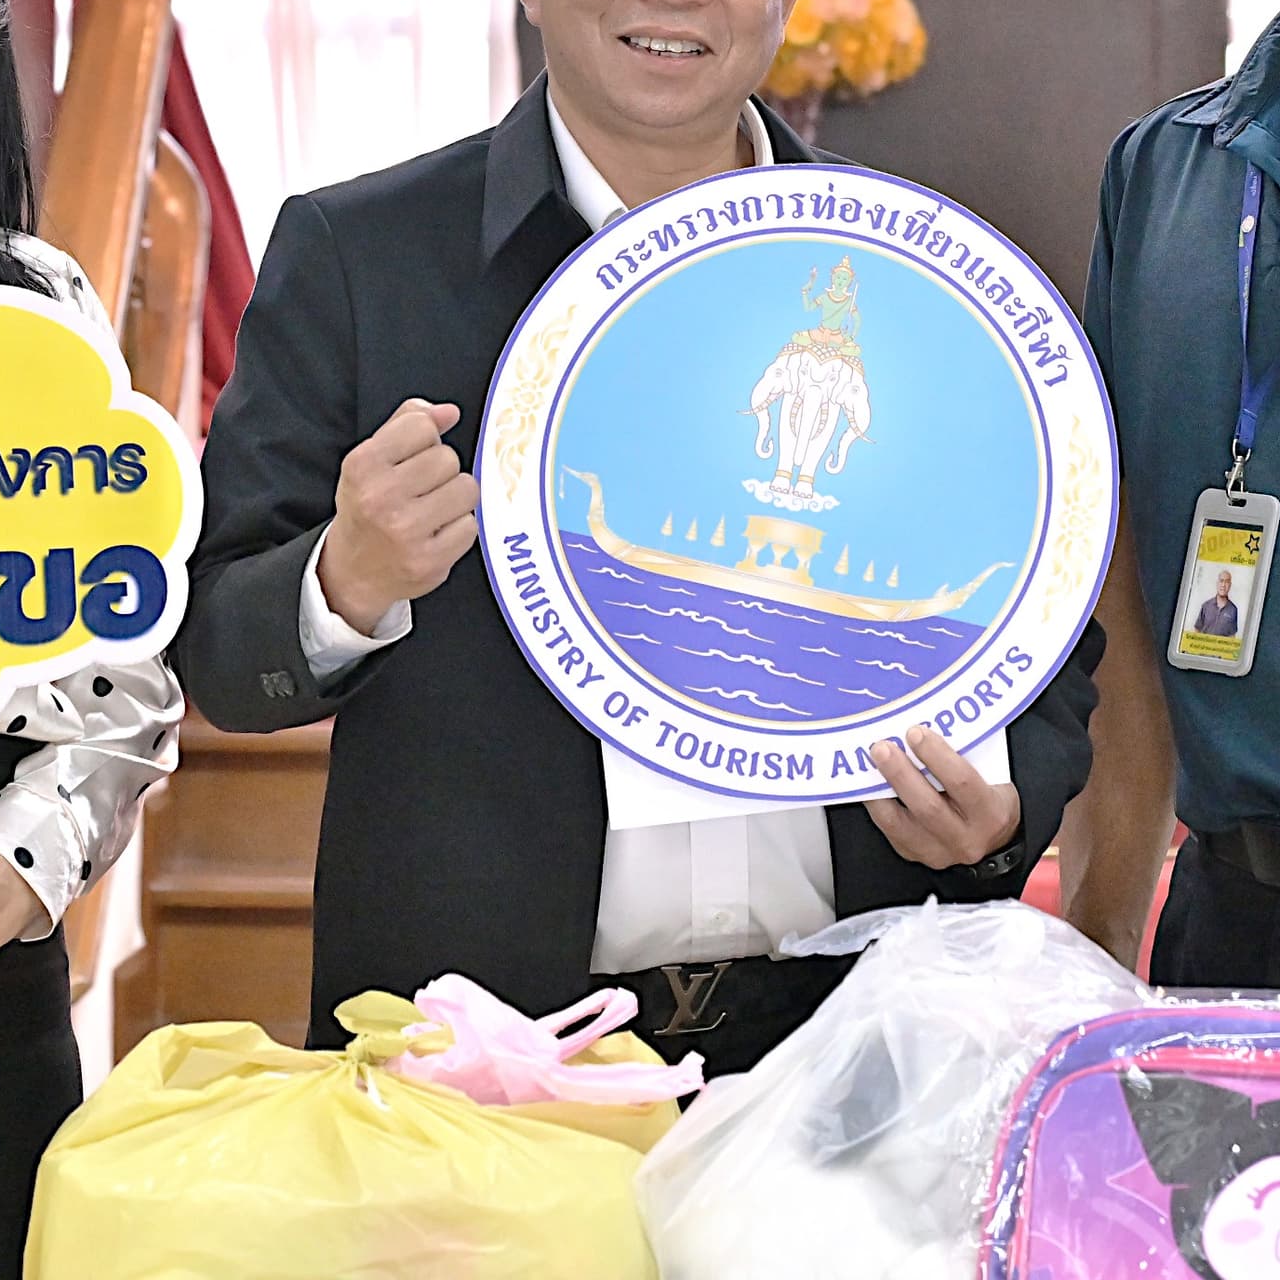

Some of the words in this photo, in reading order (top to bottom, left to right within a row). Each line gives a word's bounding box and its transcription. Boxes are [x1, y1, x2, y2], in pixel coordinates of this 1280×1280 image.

[595, 182, 1073, 388] กระทรวงการท่องเที่ยวและกีฬา
[503, 531, 605, 689] MINISTRY
[603, 690, 648, 729] OF
[655, 721, 814, 782] TOURISM
